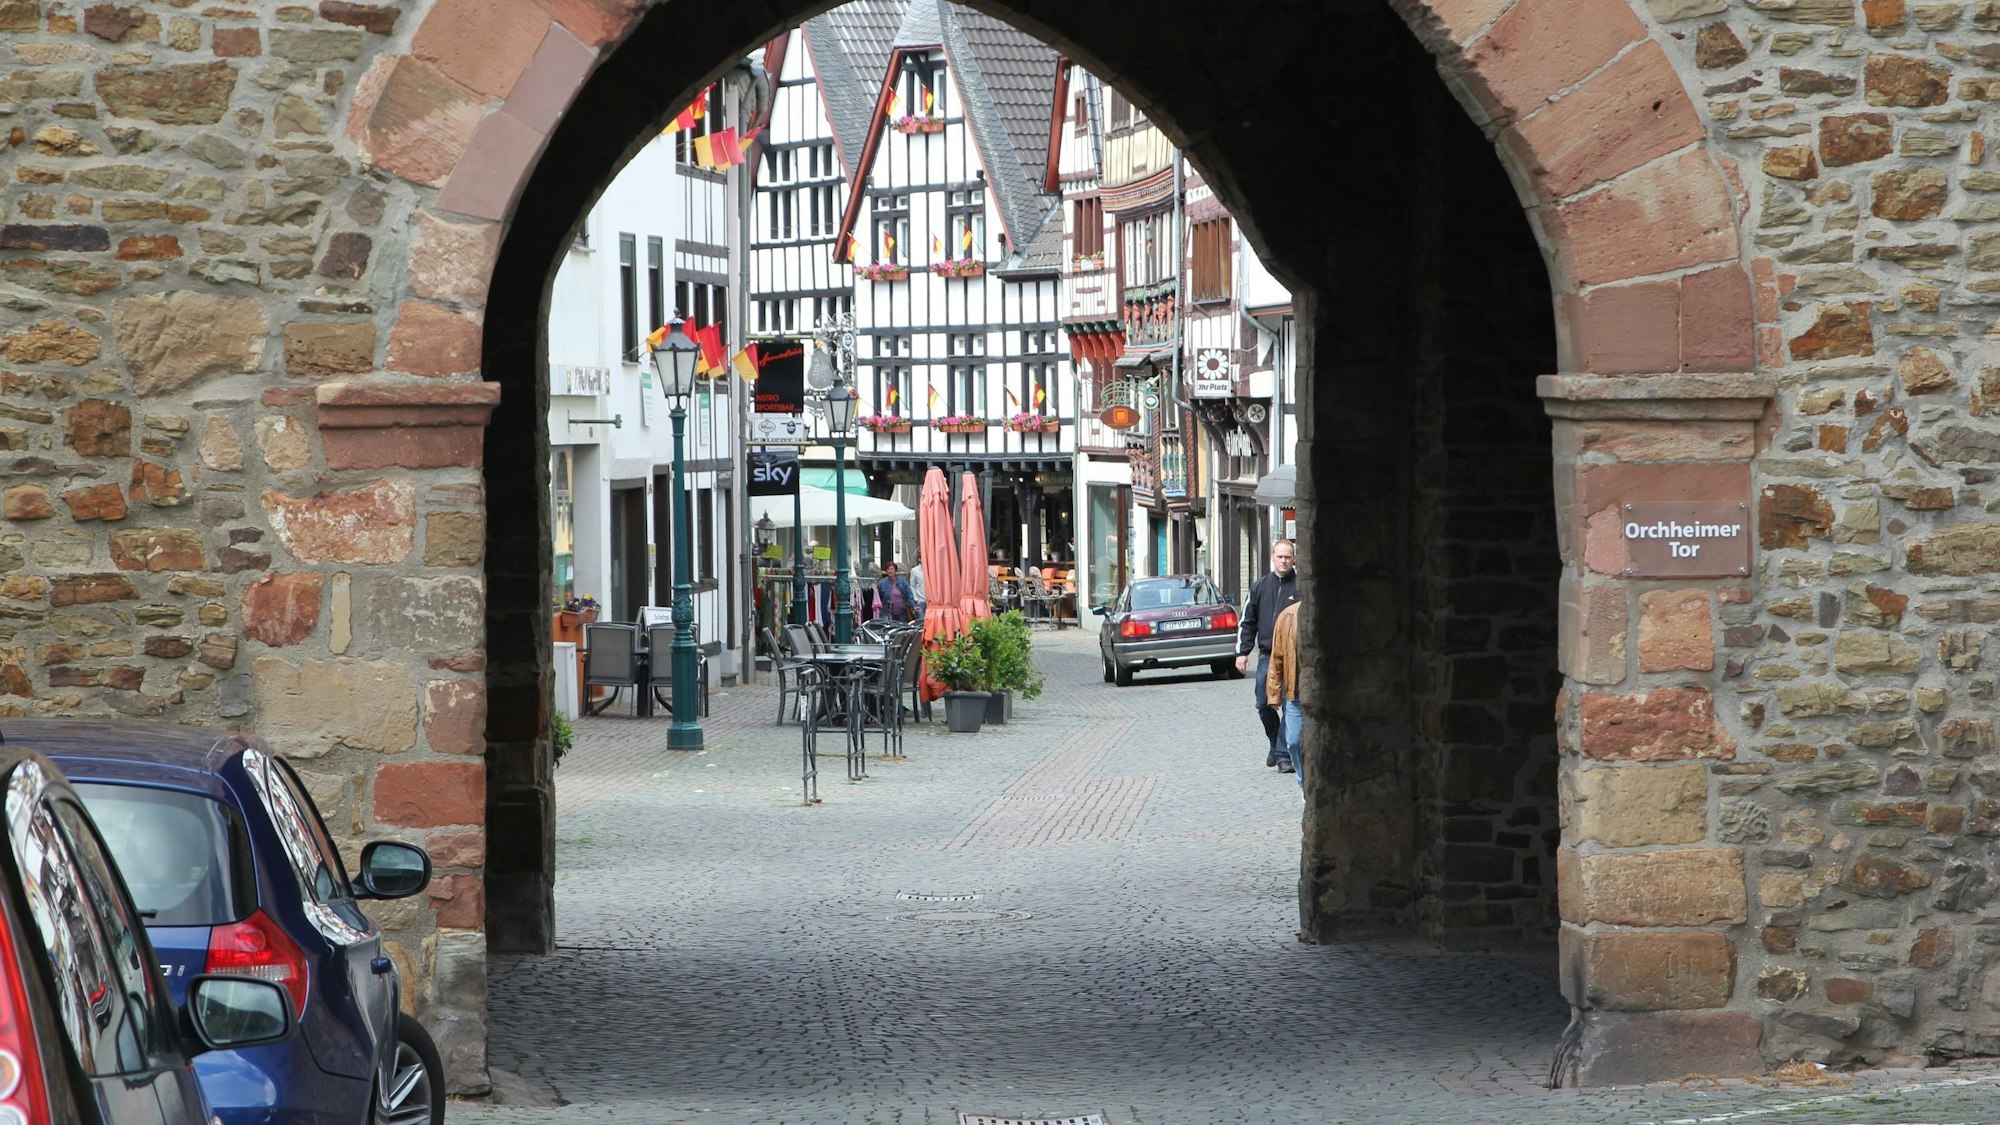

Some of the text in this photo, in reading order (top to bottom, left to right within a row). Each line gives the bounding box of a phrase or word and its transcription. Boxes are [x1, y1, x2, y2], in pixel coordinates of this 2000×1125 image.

[1210, 383, 1228, 391] Platz
[756, 394, 780, 402] BISTRO
[756, 403, 795, 412] SPORTSBAR
[753, 462, 792, 485] sky
[1625, 521, 1740, 539] Orchheimer
[1669, 541, 1700, 557] Tor
